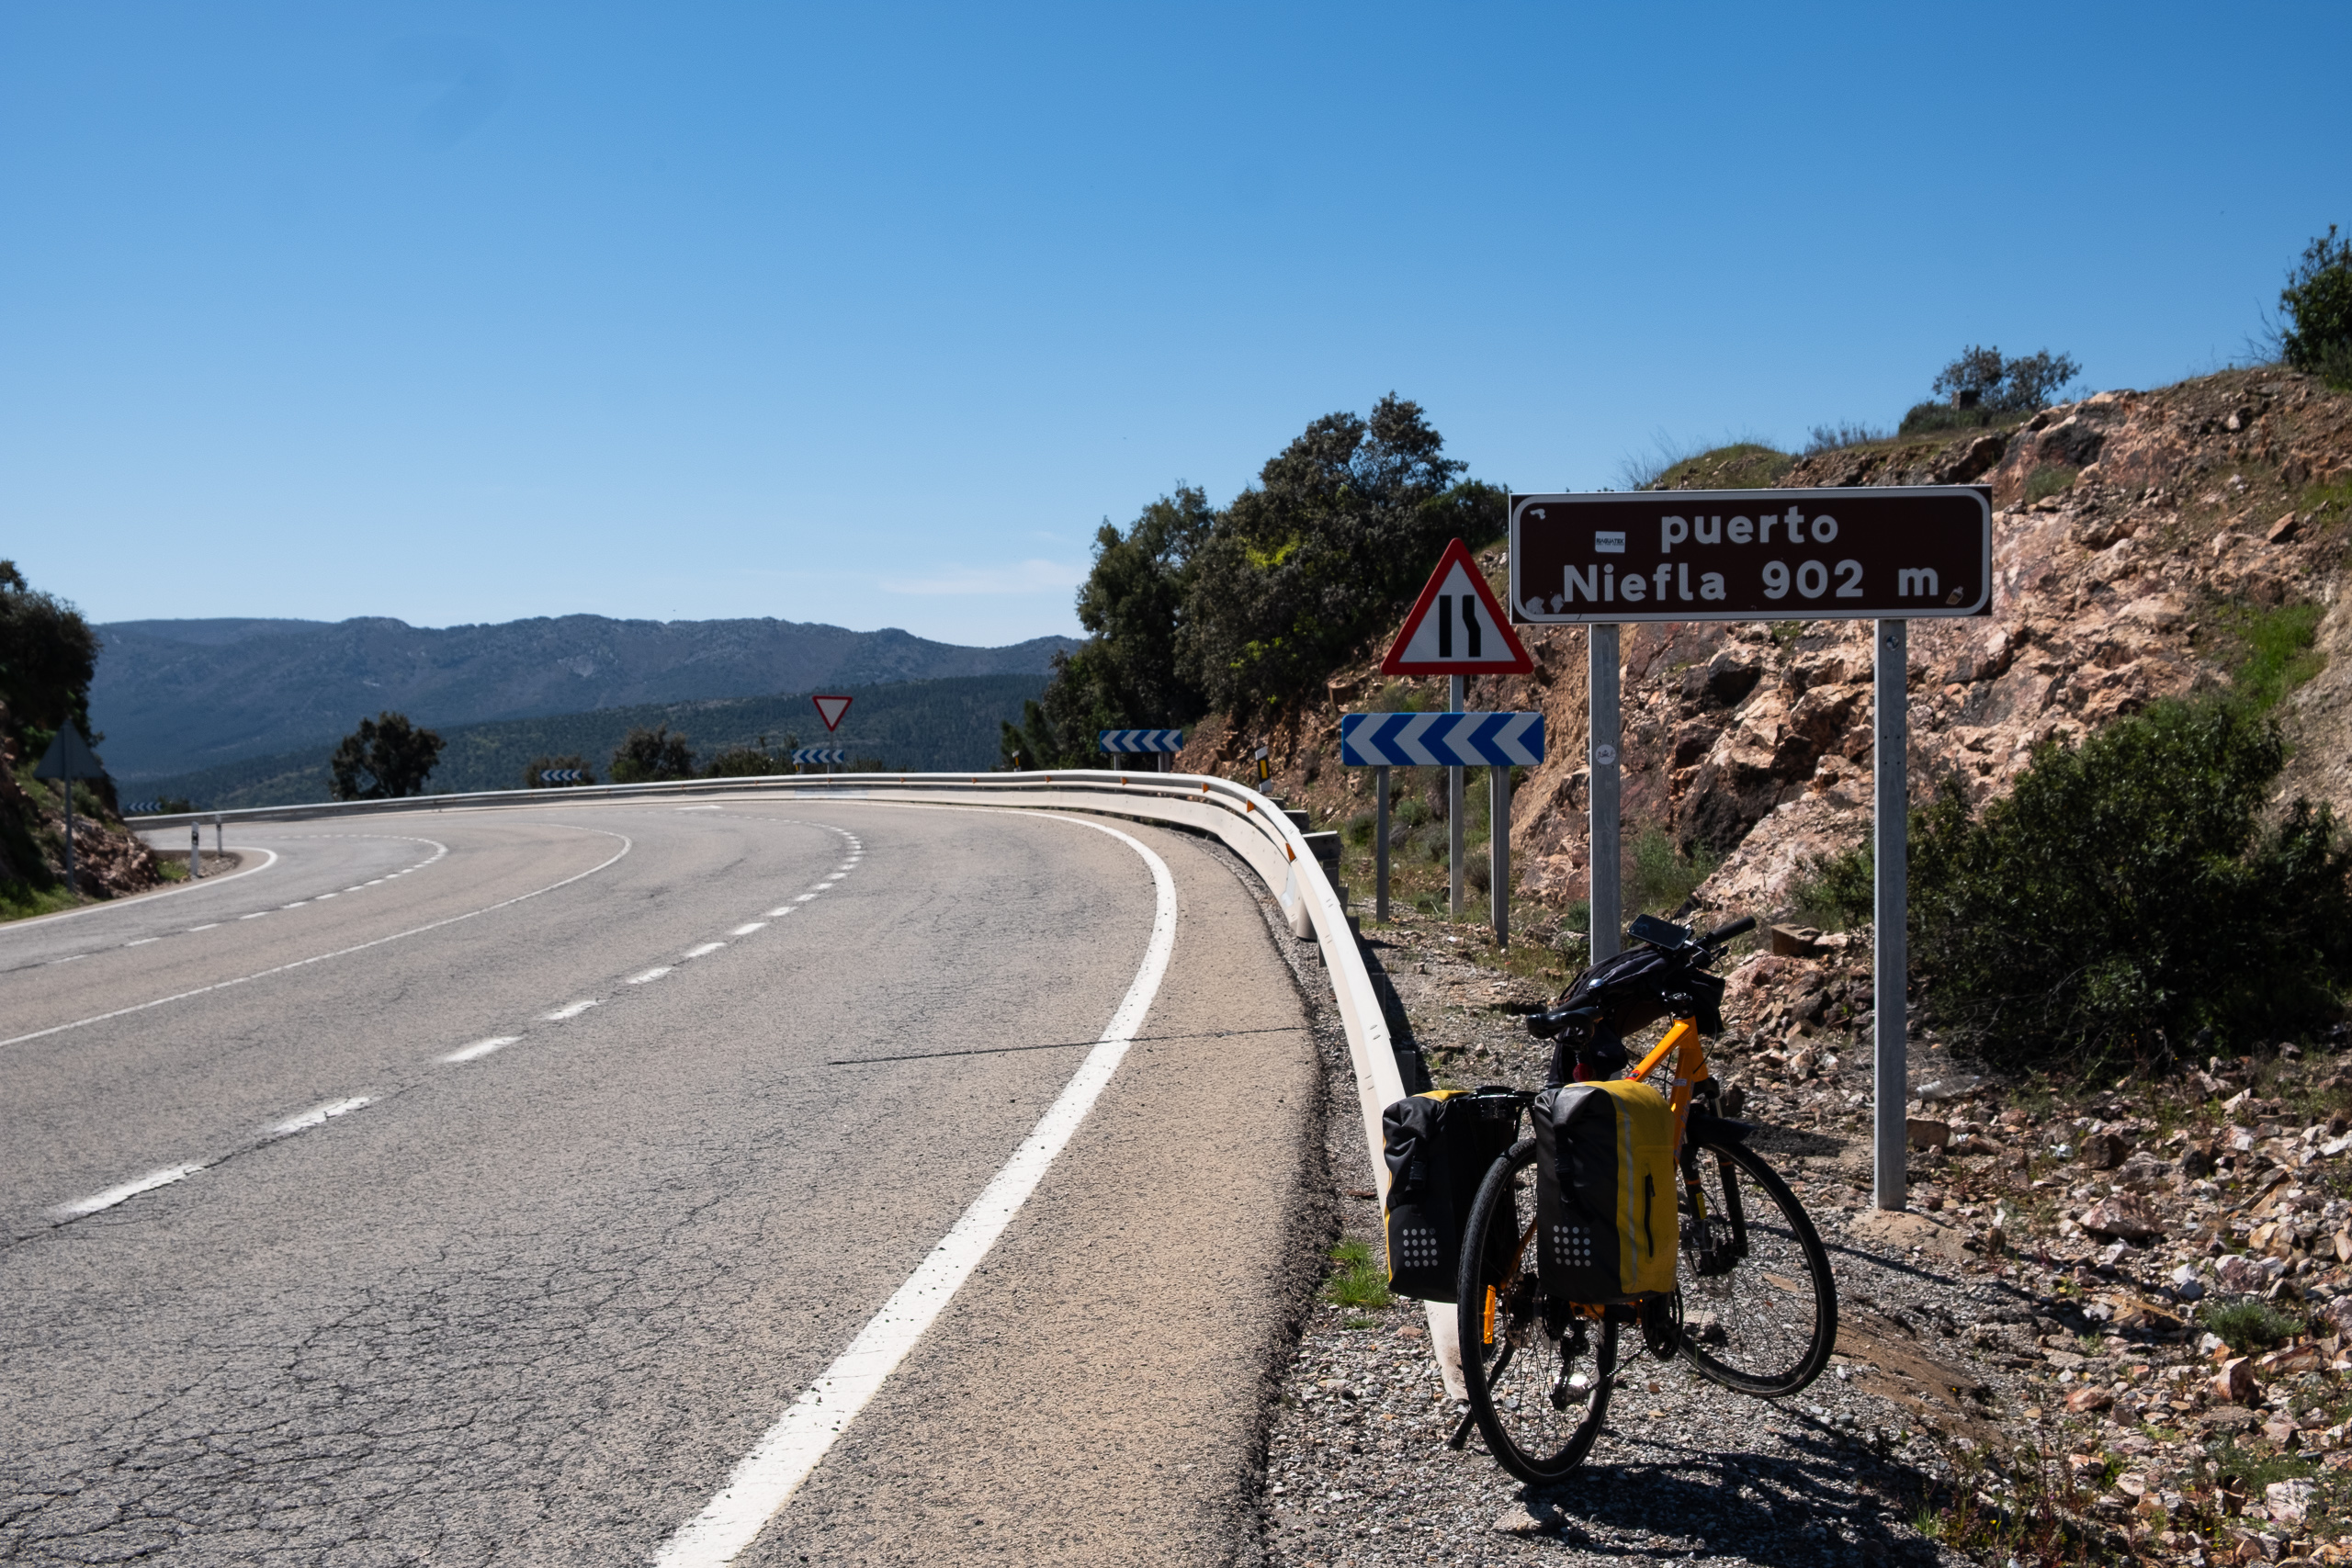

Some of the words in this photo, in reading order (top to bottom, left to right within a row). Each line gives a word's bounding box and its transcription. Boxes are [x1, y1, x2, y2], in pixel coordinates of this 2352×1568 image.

[1661, 505, 1838, 554] puerto
[1564, 562, 1727, 603] Niefla
[1761, 558, 1863, 600] 902
[1898, 567, 1939, 596] m
